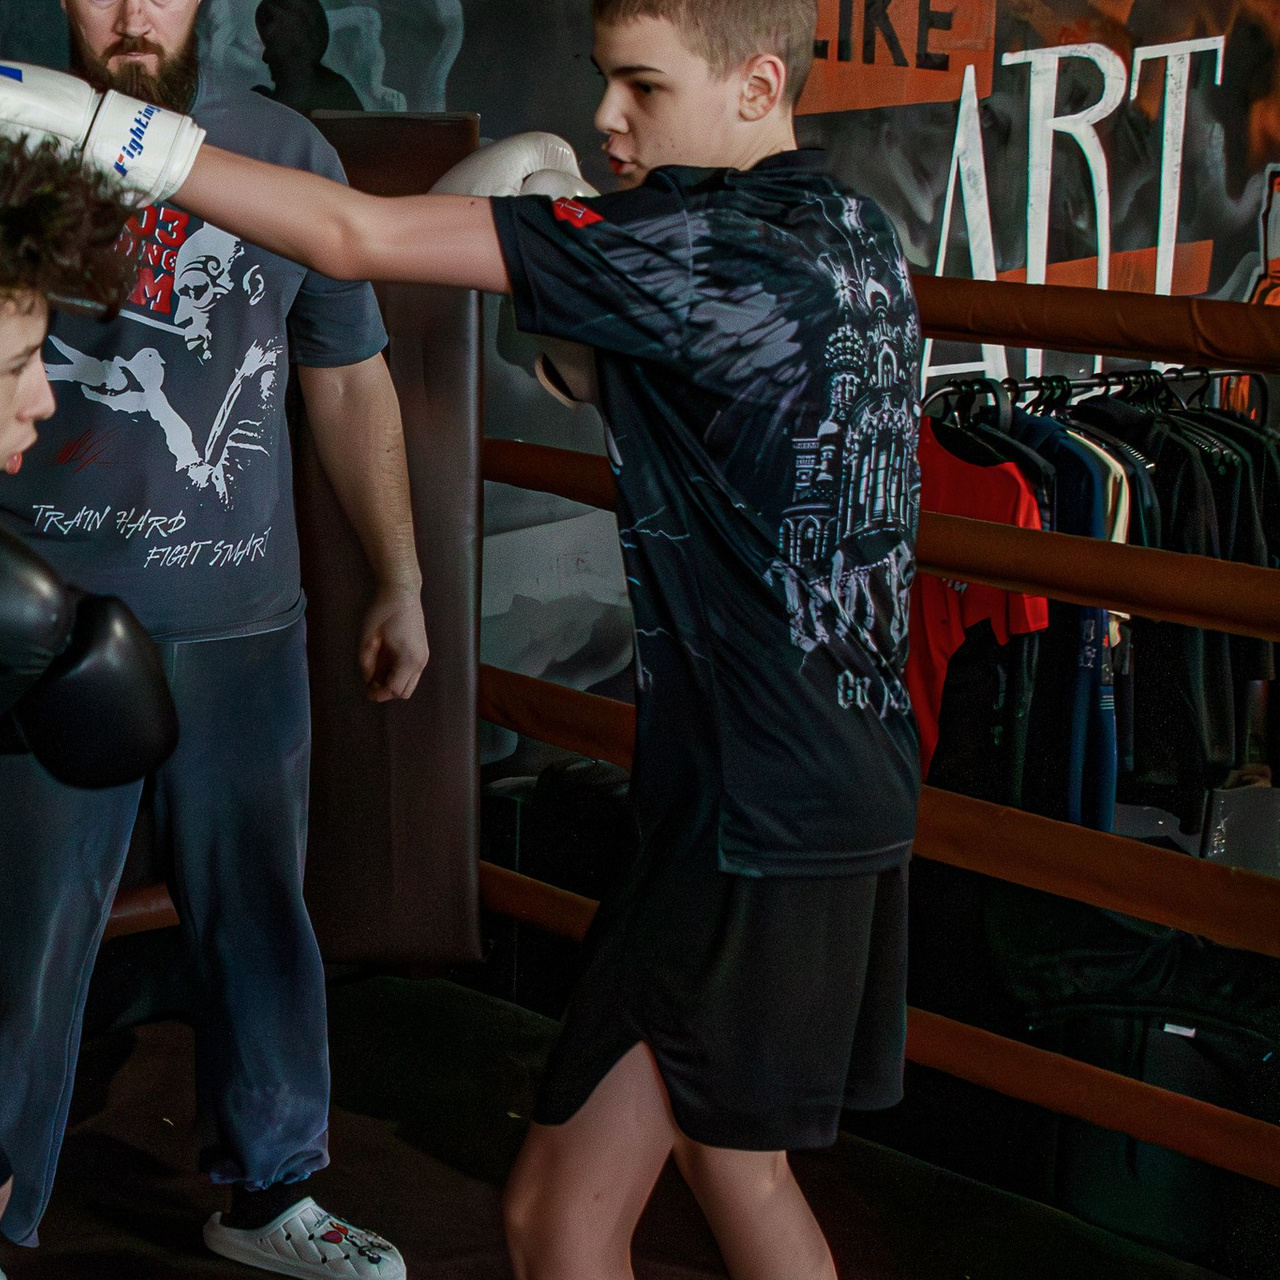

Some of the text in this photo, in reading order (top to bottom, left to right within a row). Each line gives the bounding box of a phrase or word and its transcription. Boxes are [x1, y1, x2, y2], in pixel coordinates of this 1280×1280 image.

[920, 35, 1223, 410] ART
[32, 504, 187, 539] TRAIN HARD
[143, 527, 272, 568] FIGHT SMART
